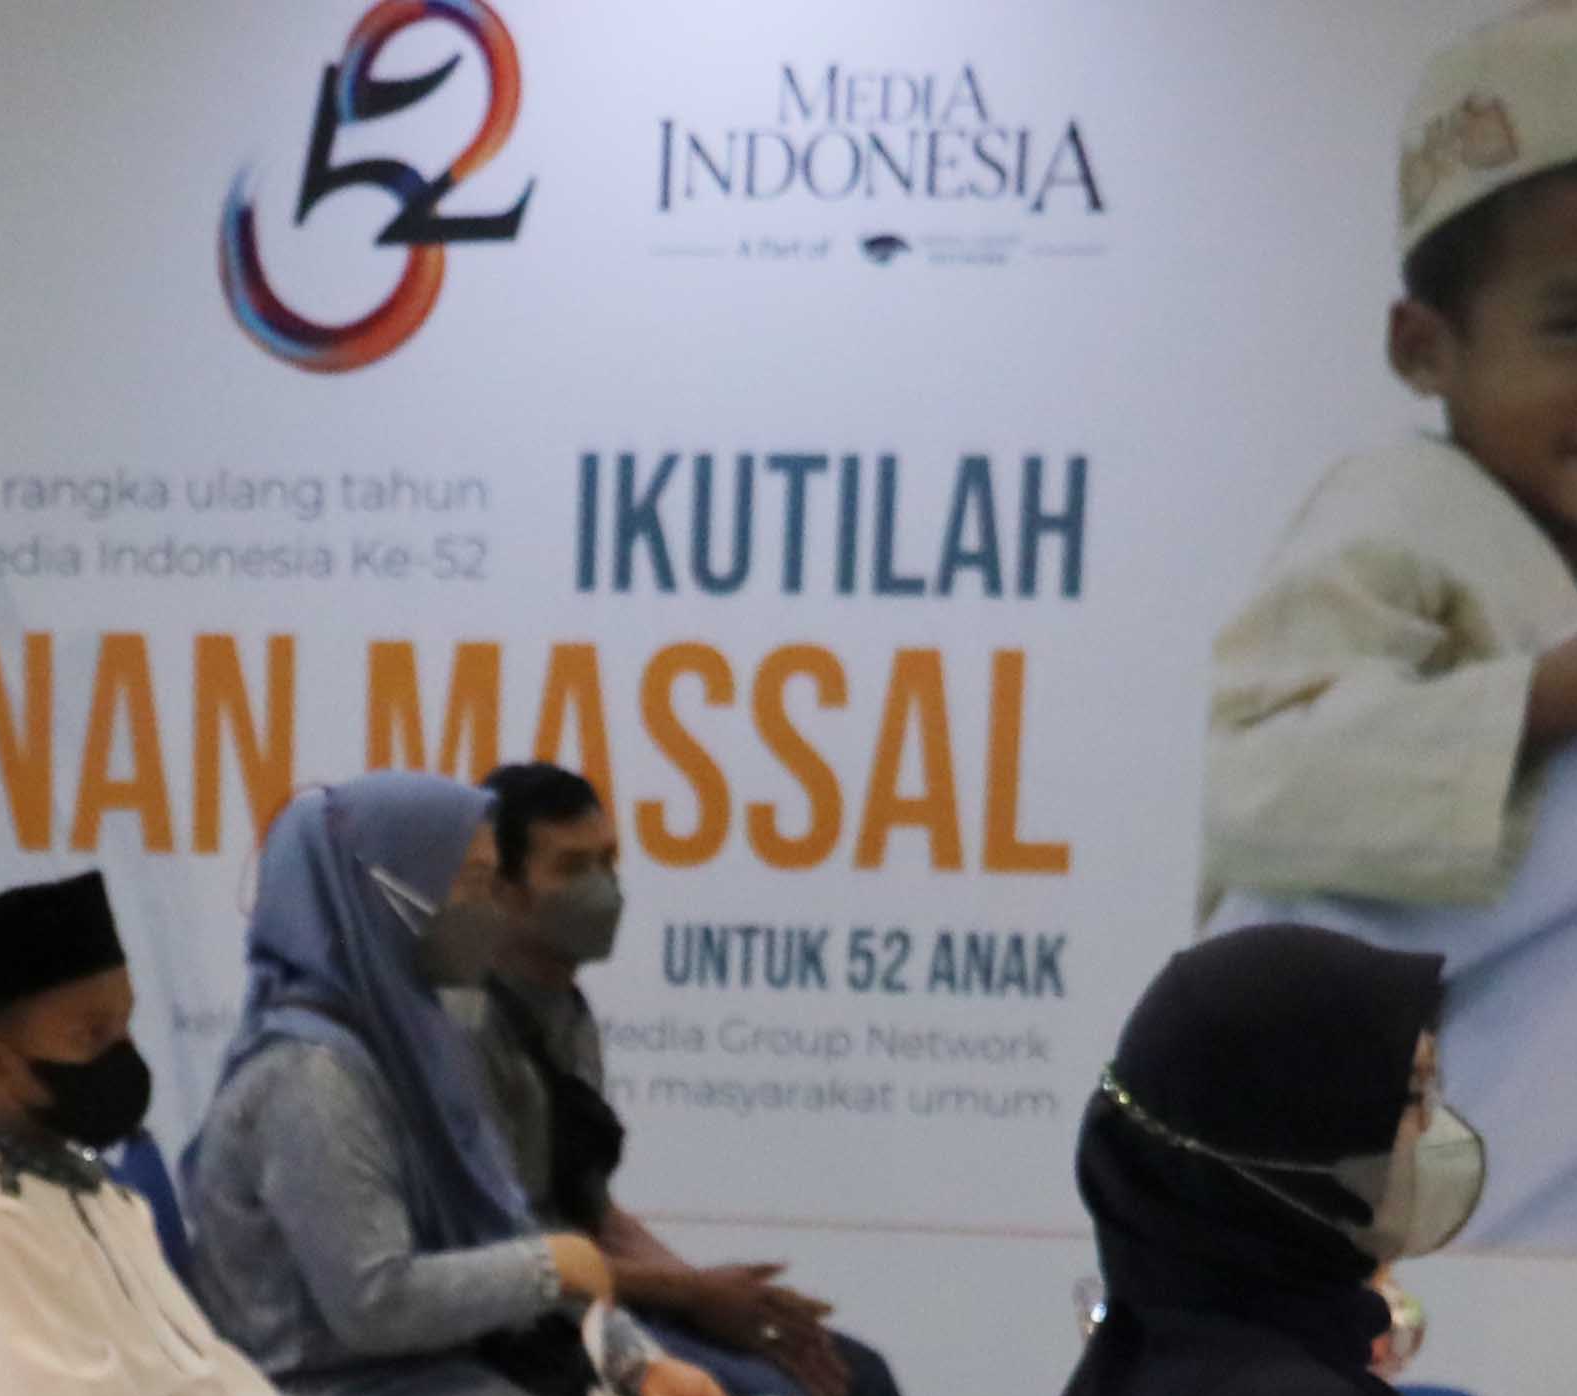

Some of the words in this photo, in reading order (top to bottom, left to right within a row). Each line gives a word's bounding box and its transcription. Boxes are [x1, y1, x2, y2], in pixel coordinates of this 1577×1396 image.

[778, 62, 990, 125] MEDIA
[659, 117, 1105, 213] INDONESIA
[2, 468, 169, 521] rangka
[185, 468, 325, 521] ulang
[339, 469, 491, 513] tahun
[576, 452, 1088, 599] IKUTILAH
[100, 536, 332, 579] Indonesia
[350, 537, 491, 580] Ke-52
[364, 641, 1070, 874] MASSAL
[663, 925, 830, 988] UNTUK
[847, 928, 910, 992] 52
[927, 932, 1066, 997] ANAK
[717, 1018, 848, 1064] Group
[865, 1022, 1051, 1064] Network
[649, 1074, 894, 1118] masyarakat
[910, 1083, 1058, 1117] umum
